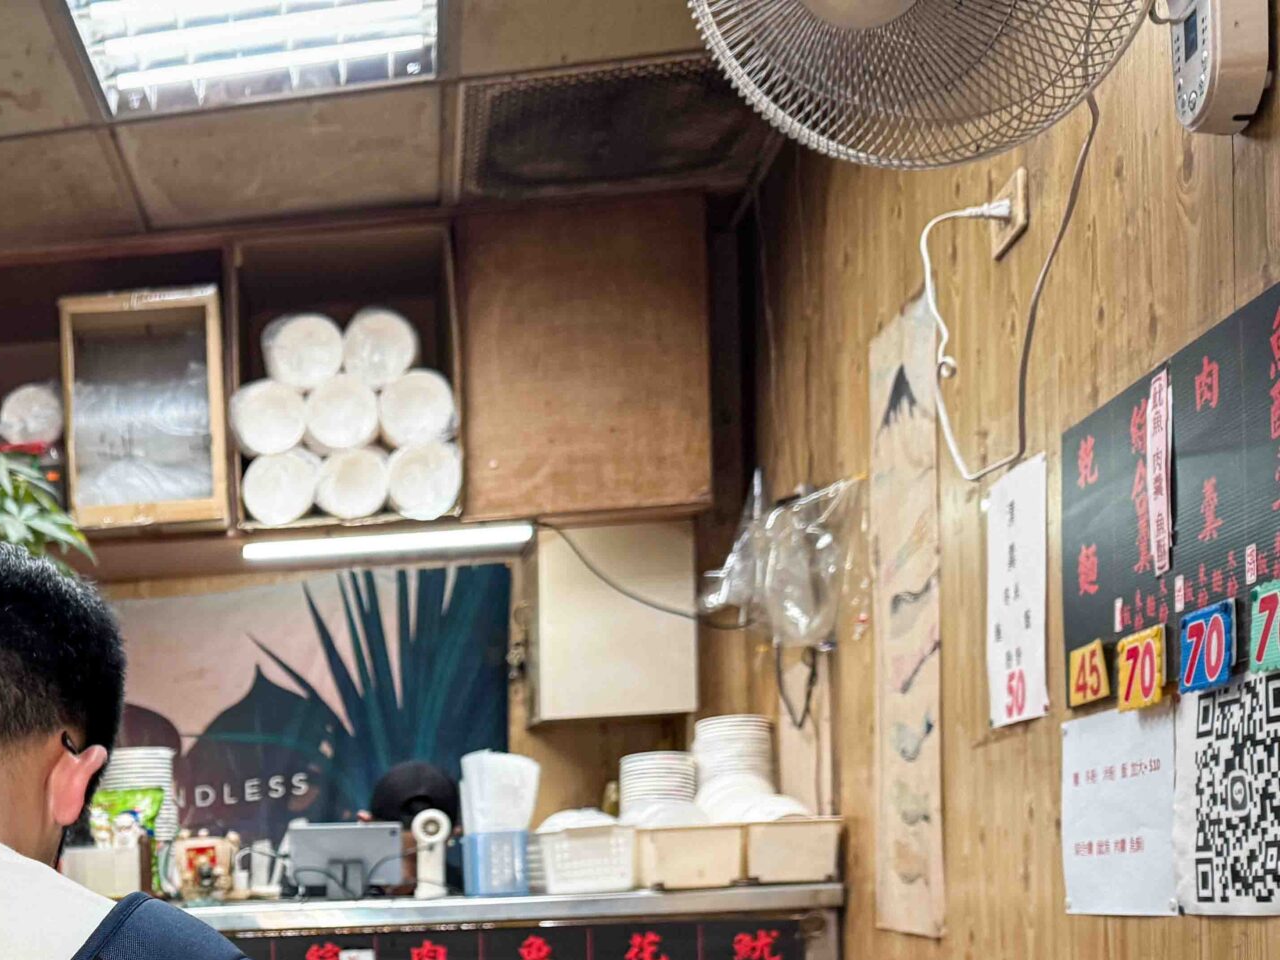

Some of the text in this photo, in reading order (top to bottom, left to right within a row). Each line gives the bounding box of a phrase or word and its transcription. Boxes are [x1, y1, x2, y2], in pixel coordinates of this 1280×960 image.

[1184, 612, 1226, 686] 70
[1256, 591, 1280, 665] 7
[1005, 668, 1027, 719] 50
[1074, 649, 1102, 699] 45
[1124, 640, 1156, 705] 70
